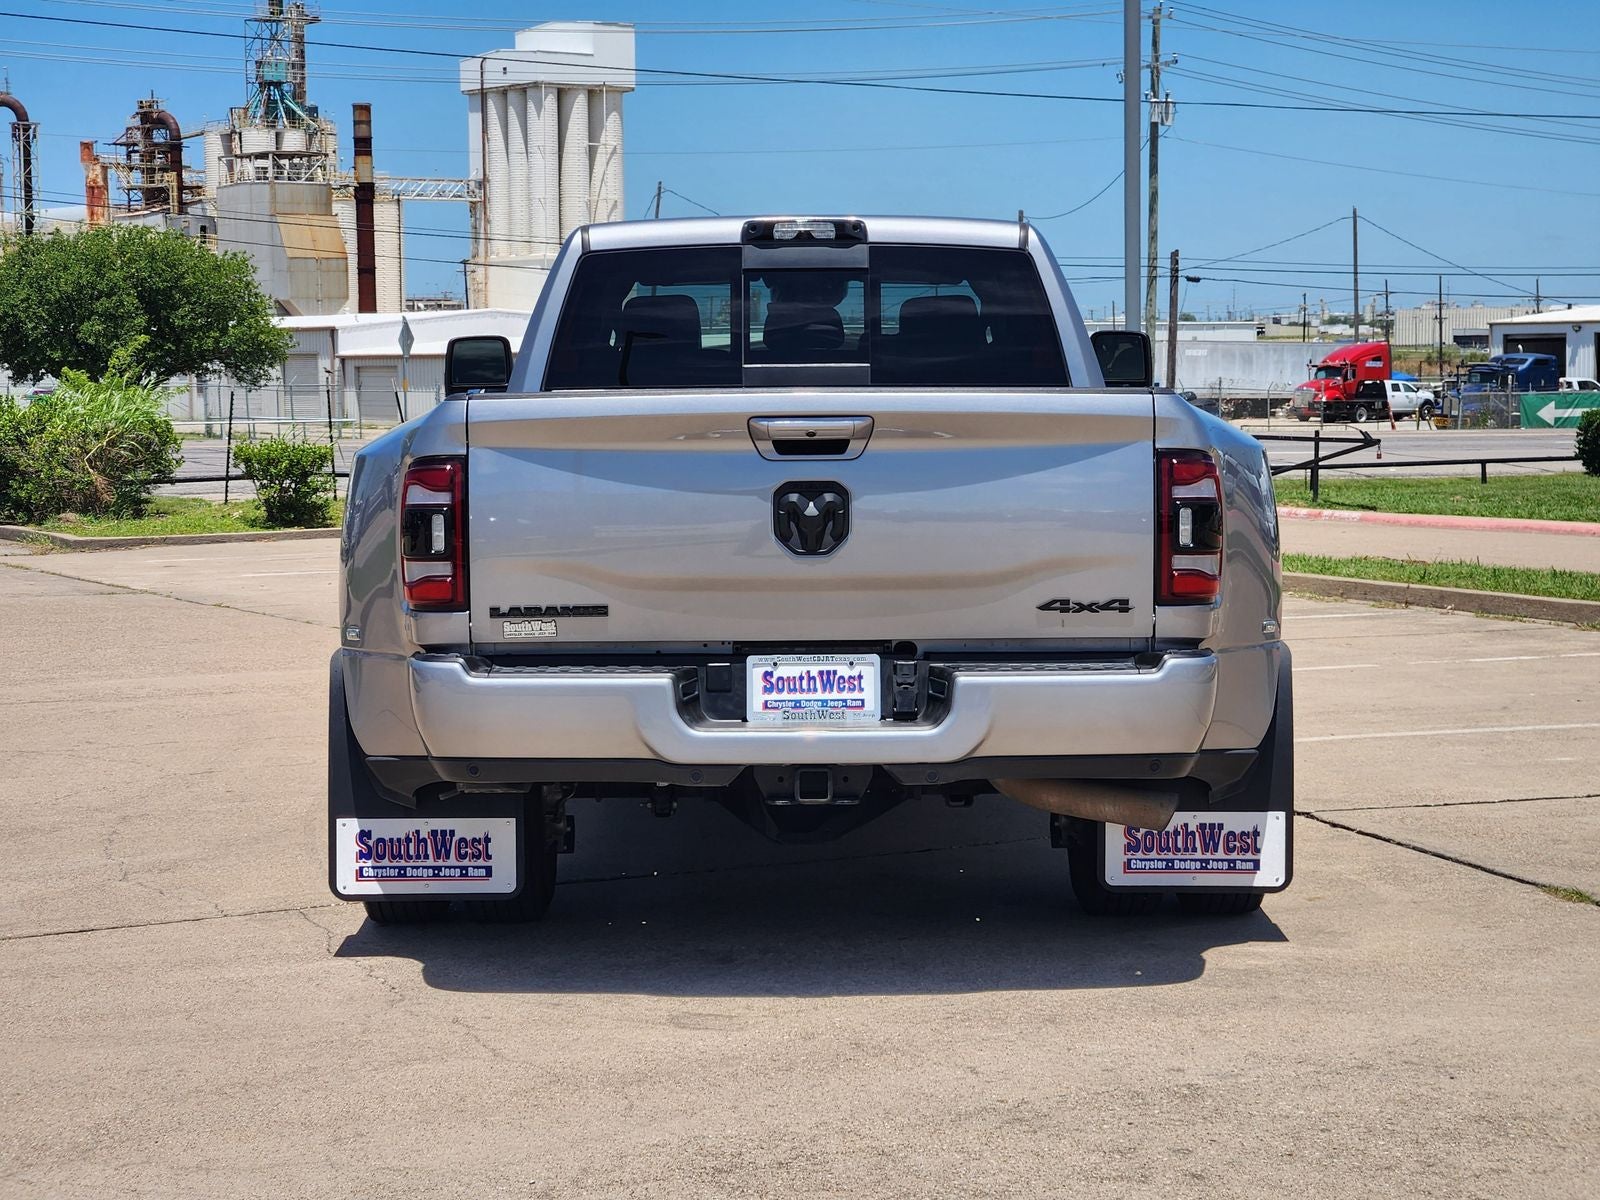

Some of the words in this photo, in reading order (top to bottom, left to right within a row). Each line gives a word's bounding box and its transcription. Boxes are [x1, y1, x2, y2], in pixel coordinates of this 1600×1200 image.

[1035, 598, 1135, 613] 4x4
[503, 620, 557, 632] SouthWest
[762, 669, 865, 695] SouthWest
[767, 699, 795, 709] Chrysler
[801, 699, 822, 709] Dodge
[827, 699, 843, 708] Jeep
[847, 699, 862, 707] Ram
[782, 710, 847, 721] SouthWest
[1123, 822, 1262, 856] SouthWest
[355, 829, 493, 863] SouthWest
[1130, 859, 1167, 870] Chrysler
[1174, 859, 1201, 870] Dodge
[1207, 859, 1229, 871] Jeep
[1235, 859, 1254, 869] Ram
[362, 867, 399, 877] Chrysler
[406, 867, 434, 877] Dodge
[439, 867, 461, 878] Jeep
[468, 867, 486, 876] Ram
